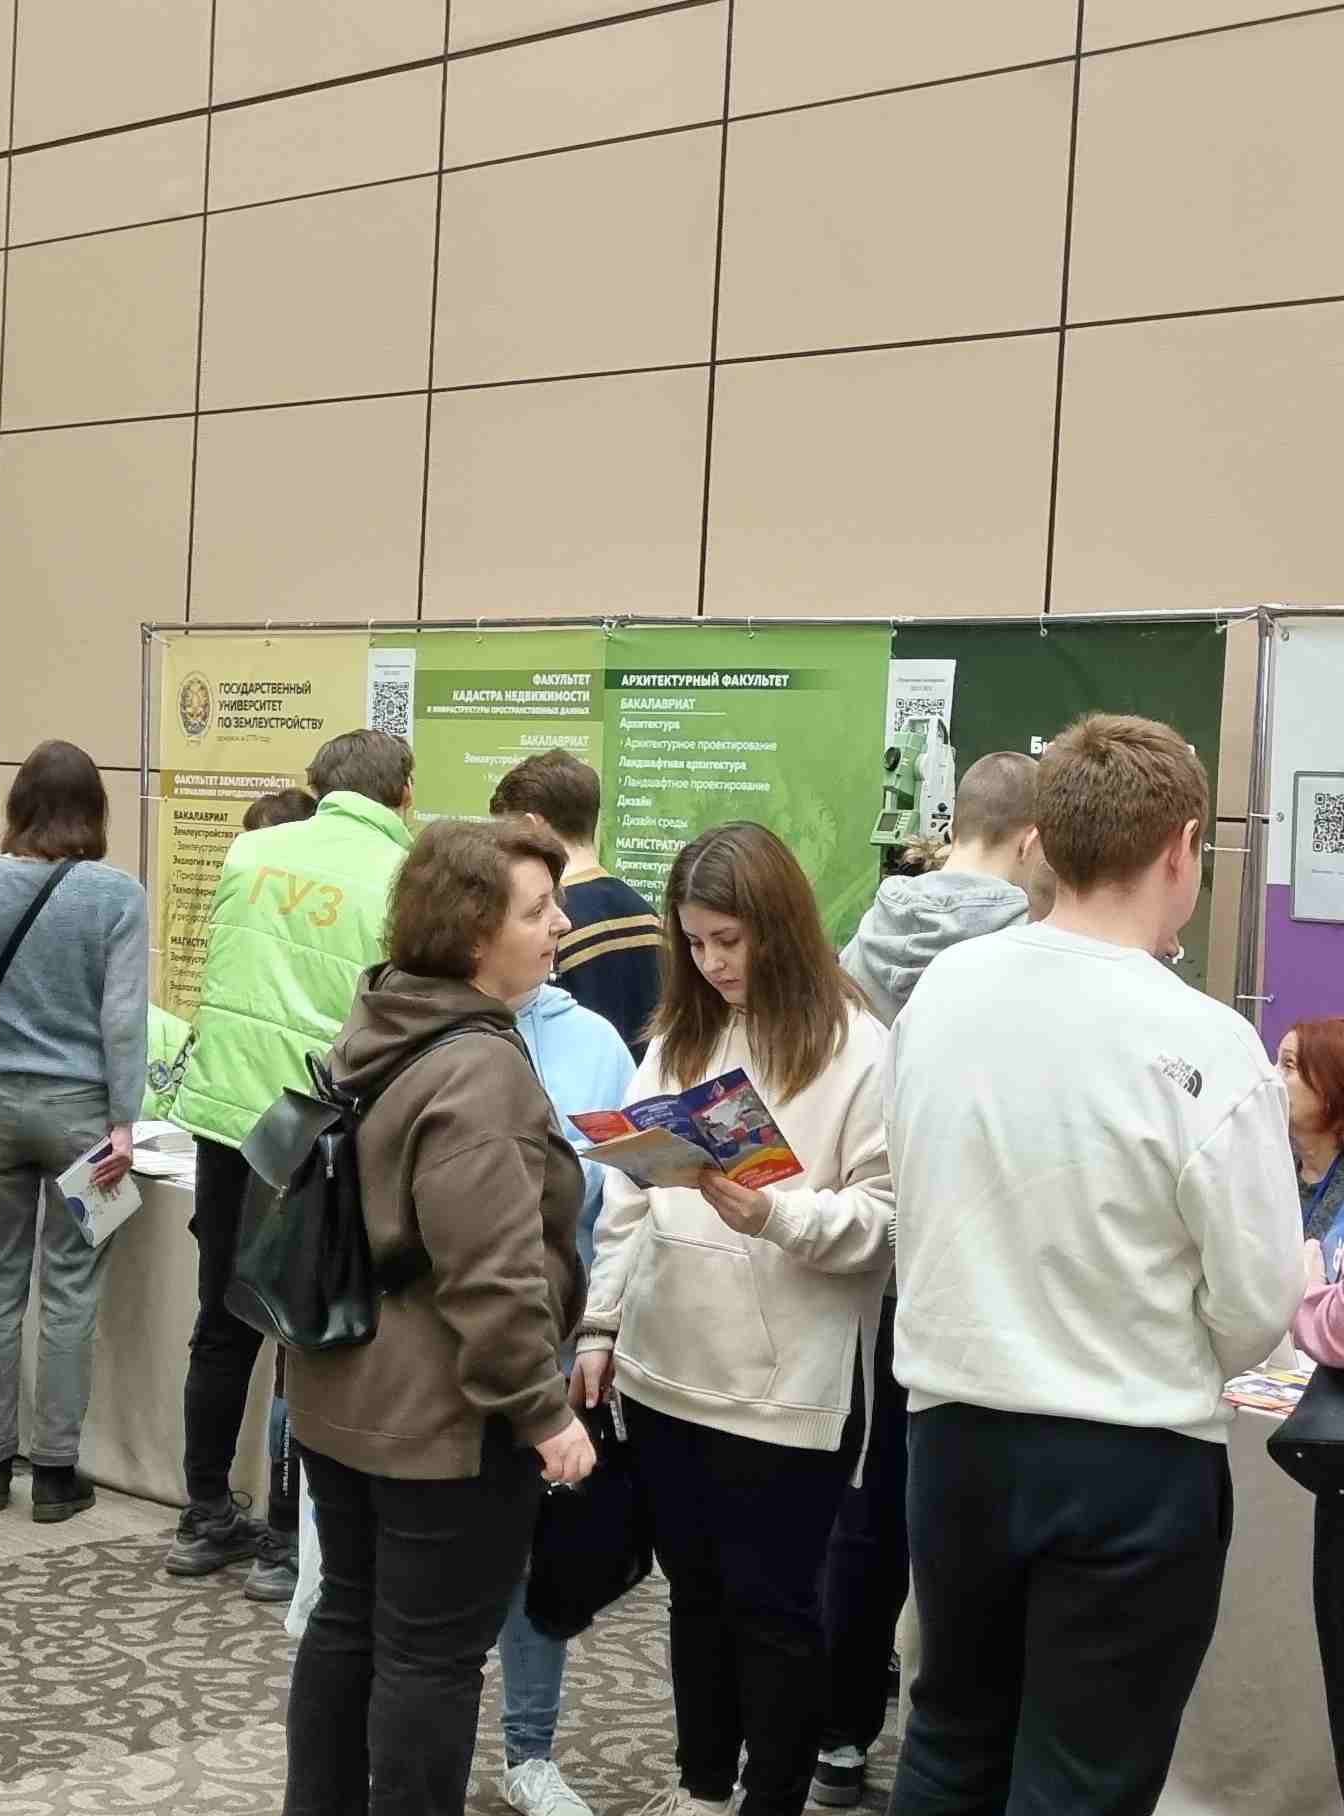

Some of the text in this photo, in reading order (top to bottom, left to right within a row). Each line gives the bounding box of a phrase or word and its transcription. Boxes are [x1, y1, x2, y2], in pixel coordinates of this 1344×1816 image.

[532, 673, 592, 686] ФАКУЛЬТЕТ
[621, 672, 790, 687] АРХИТЕКТУРНЫЙ ФАКУЛЬТЕТ
[219, 681, 312, 695] ГОСУДАРСТВЕННЫЙ
[453, 690, 590, 702] КАДАСТРА НЕДВИЖИМОСТИ
[218, 700, 283, 712] УНИВЕРСИТЕТ
[620, 697, 696, 710] БАКАЛАВРИАТ
[218, 716, 324, 730] ПО ЗЕМЛЕУСТРОЙСТВУ
[619, 718, 680, 731] Архитектура
[520, 735, 590, 746] БАКАЛАВРИАТ
[624, 738, 696, 751] Архитектурное
[619, 756, 747, 772] Ландшафтная архитектура
[623, 776, 689, 790] Ландшафтное
[617, 795, 652, 807] Дизайн
[174, 811, 228, 822] БАКАЛАВРИАТ
[616, 838, 688, 850] МАГИСТРАТУР
[248, 866, 343, 928] ГУЗ
